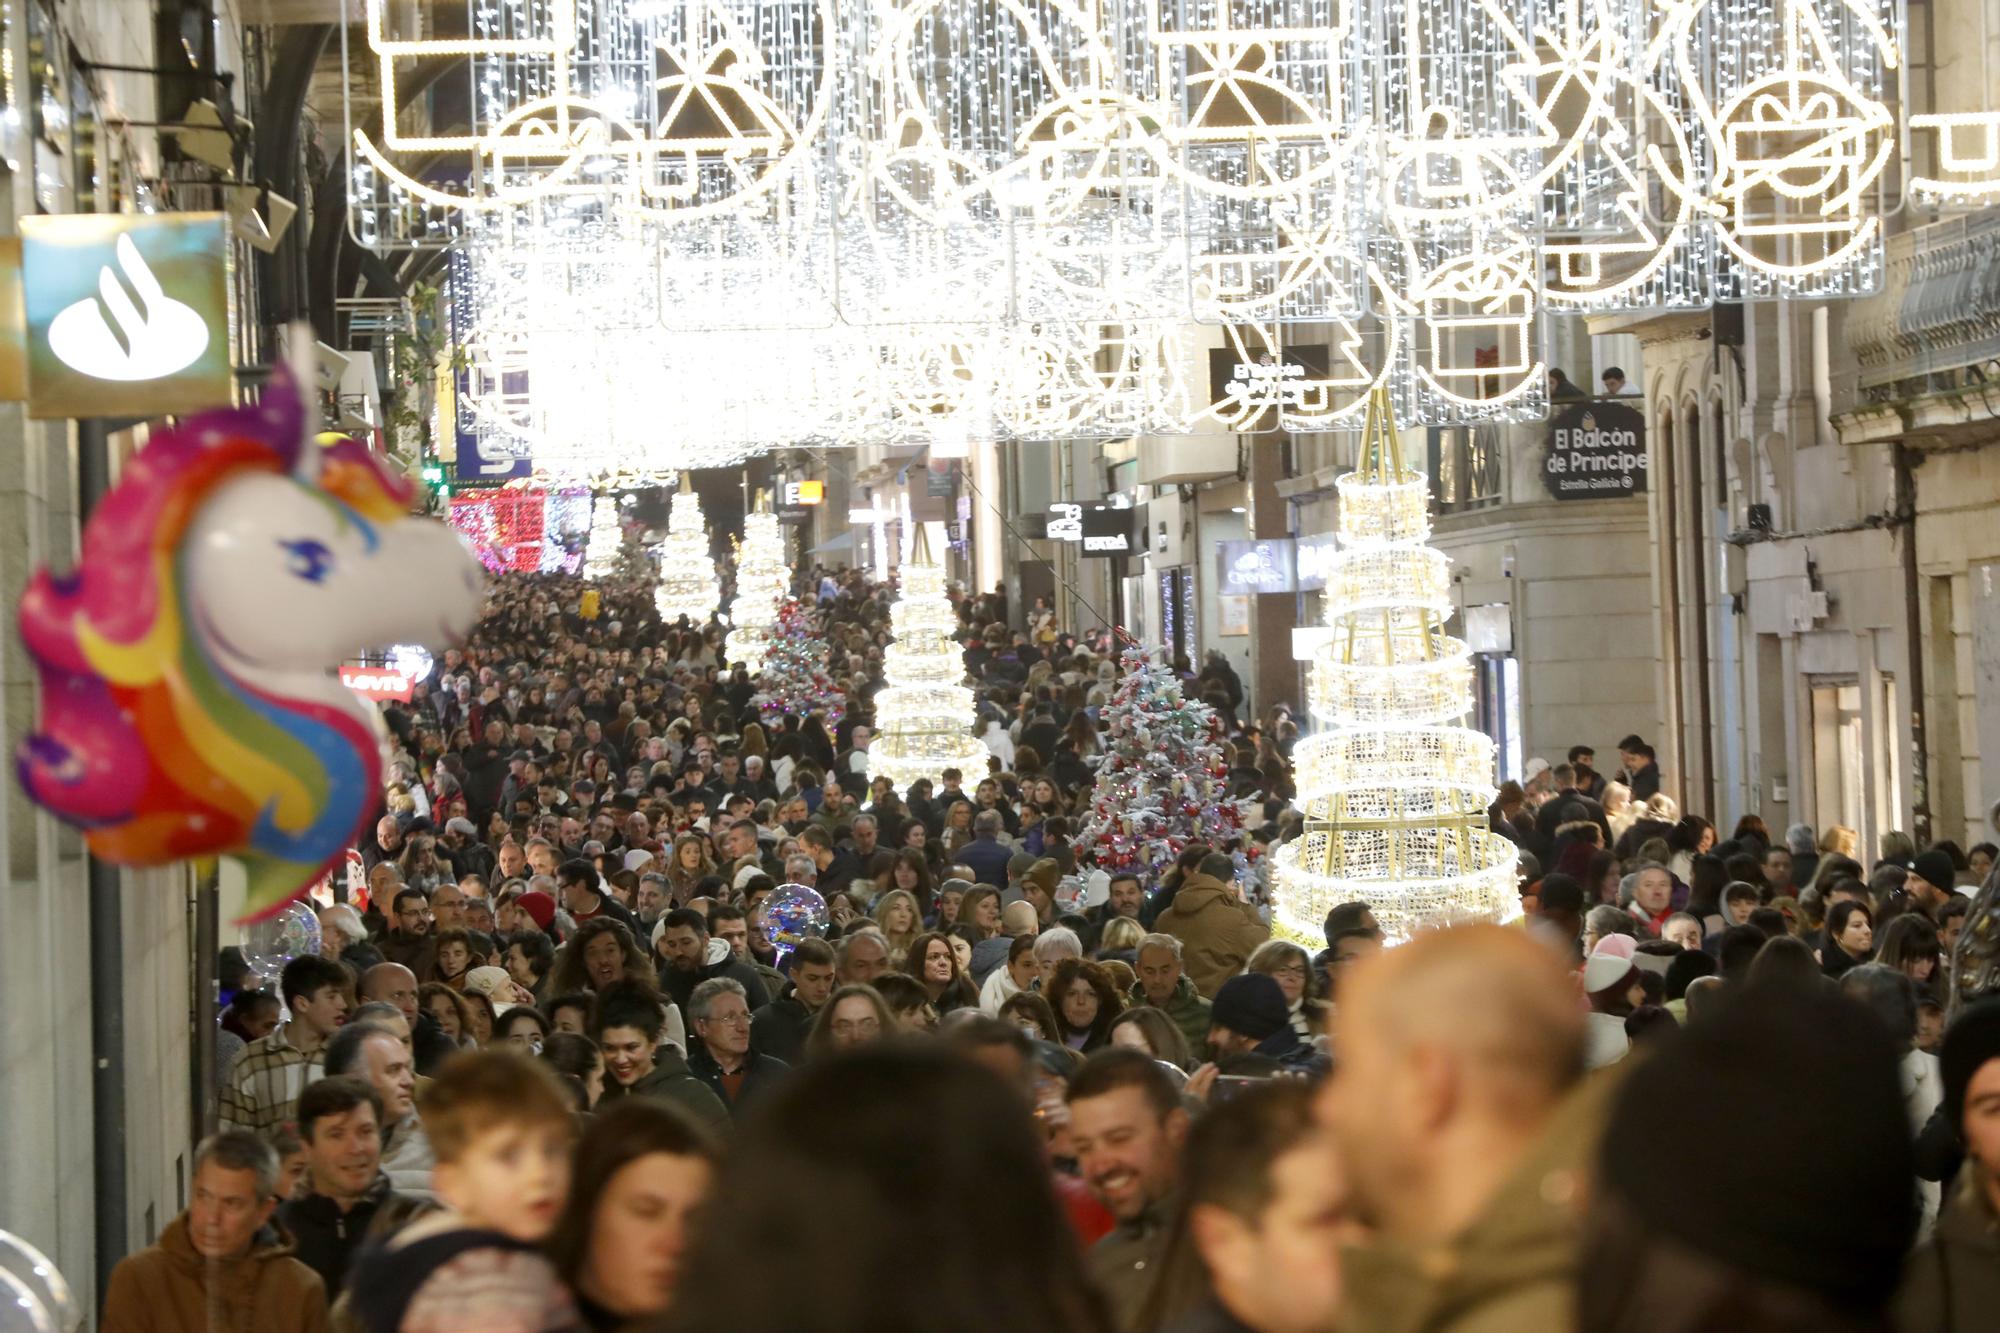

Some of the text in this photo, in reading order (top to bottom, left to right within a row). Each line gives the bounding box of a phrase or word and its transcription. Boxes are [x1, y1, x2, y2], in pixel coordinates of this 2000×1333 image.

[1555, 427, 1636, 449] El Balcón
[1547, 453, 1566, 472] de
